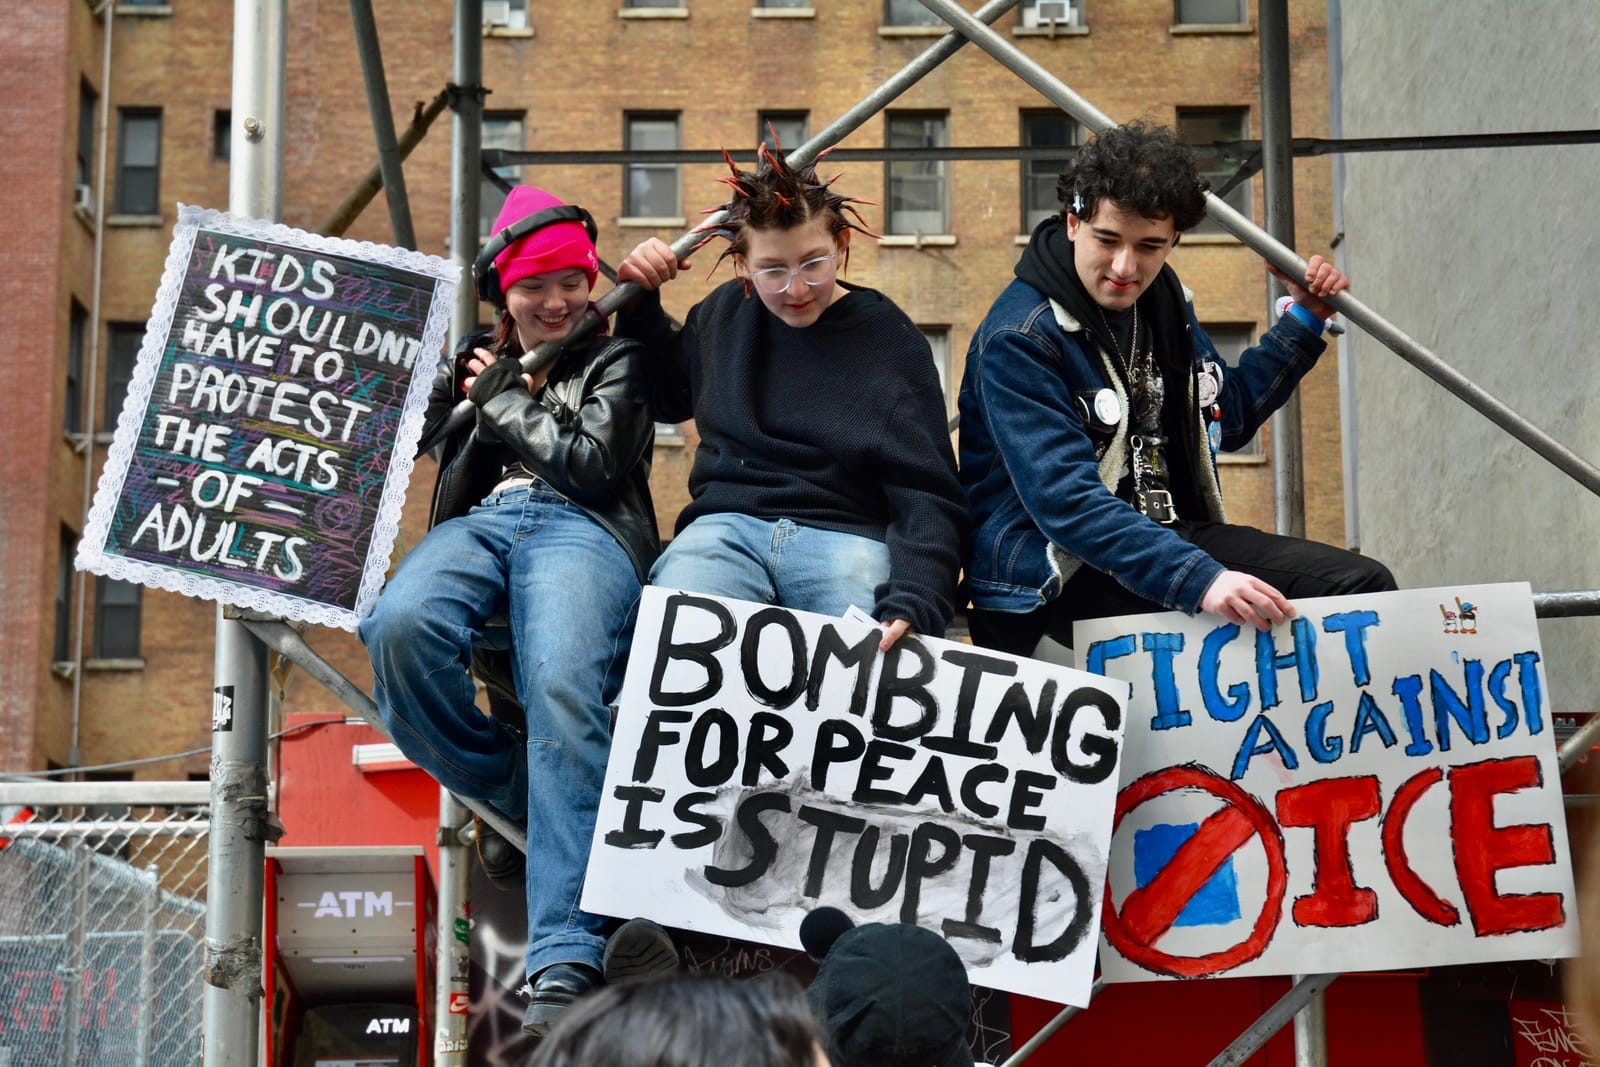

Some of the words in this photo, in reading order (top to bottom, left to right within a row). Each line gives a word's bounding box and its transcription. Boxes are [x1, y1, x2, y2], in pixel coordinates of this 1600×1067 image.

[210, 244, 336, 299] KIDS
[184, 319, 283, 367] HAVE
[288, 343, 344, 381] TO
[196, 283, 422, 369] SHOULDNT
[169, 363, 372, 442] PROTEST
[155, 415, 232, 462] THE
[245, 438, 341, 490] ACTS
[131, 503, 307, 582] ADULTS
[649, 591, 1122, 784] BOMBING
[1230, 651, 1543, 780] AGAINST
[632, 708, 794, 787] FOR
[811, 719, 1057, 832] PEACE
[605, 786, 723, 849] IS
[704, 792, 1093, 962] STUPID
[1275, 755, 1566, 937] ICE
[314, 891, 393, 918] ATM
[365, 1018, 410, 1034] ATM
